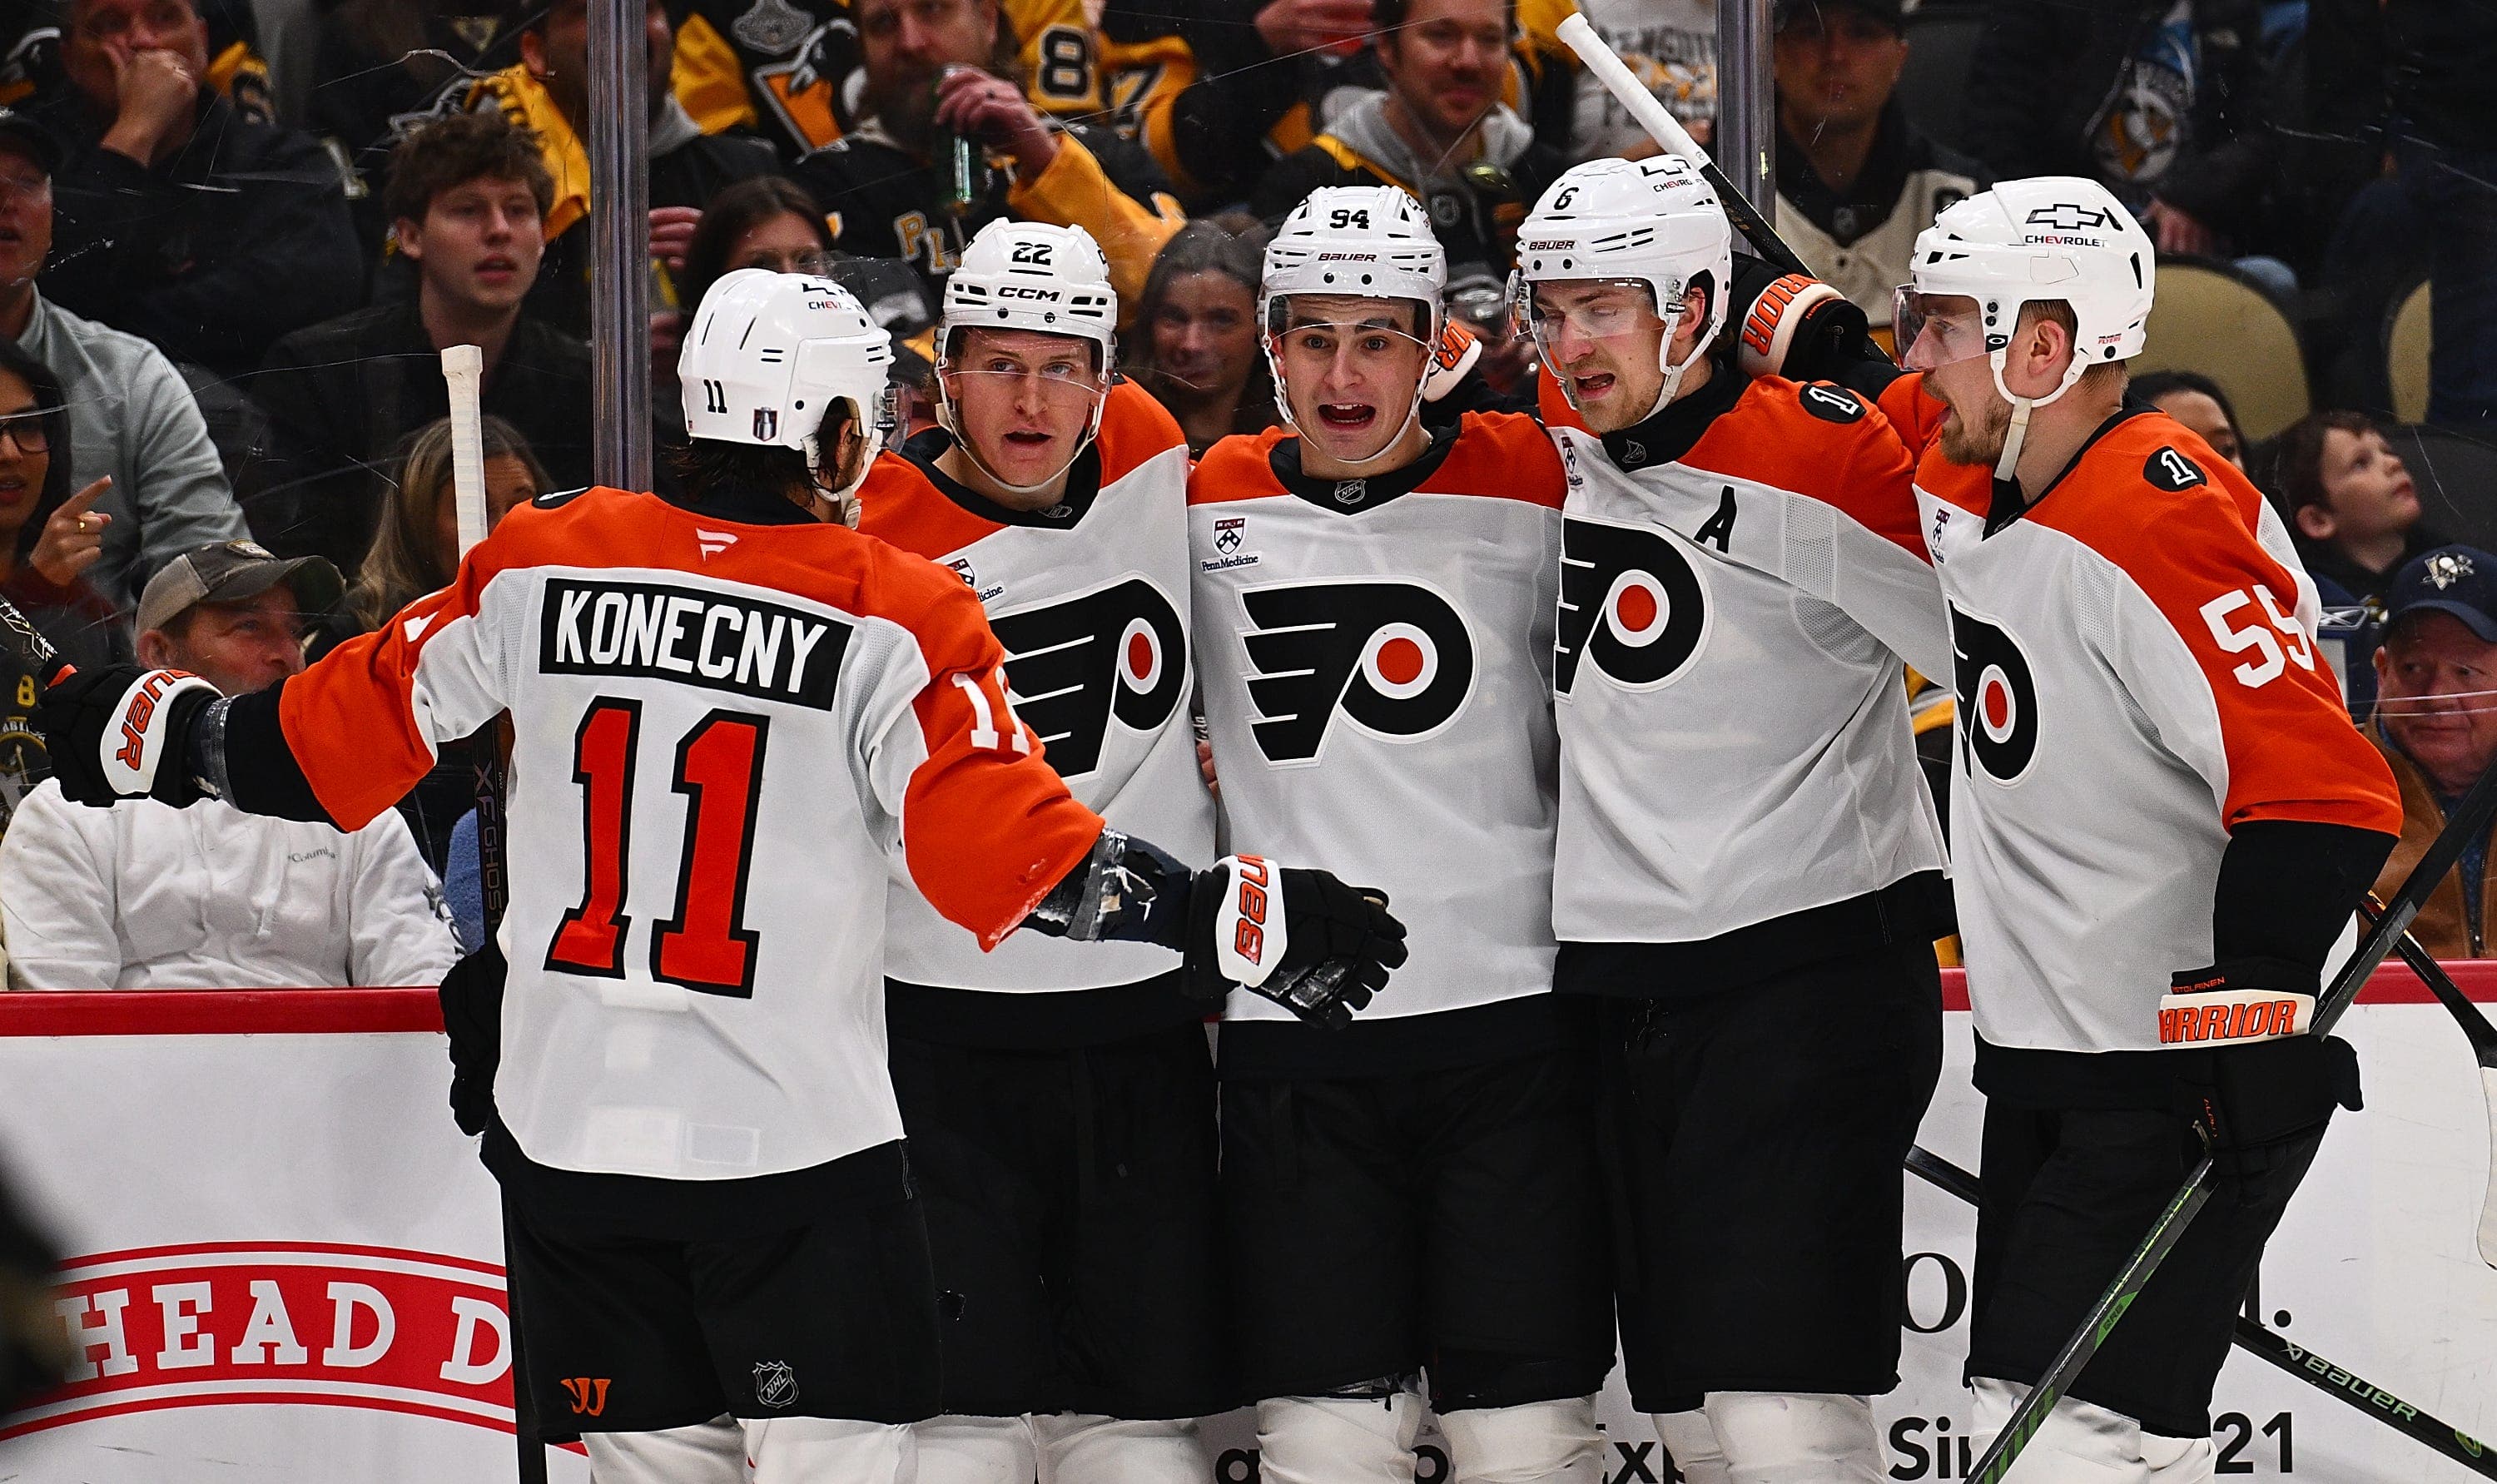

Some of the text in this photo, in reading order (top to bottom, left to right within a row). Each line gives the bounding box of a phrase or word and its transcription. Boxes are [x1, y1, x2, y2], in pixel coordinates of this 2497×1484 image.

[1553, 187, 1580, 211] 6
[1329, 209, 1370, 230] 94
[1011, 241, 1053, 266] 22
[2024, 235, 2107, 248] CHEVROLET
[997, 285, 1061, 302] CCM
[703, 379, 727, 414] 11
[2161, 449, 2198, 485] 1
[1693, 484, 1737, 554] A
[1201, 554, 1258, 572] Penn Medicine
[556, 589, 828, 693] KONECNY
[2199, 584, 2316, 689] 55
[543, 694, 771, 1000] 11
[2172, 976, 2226, 994] STOLAINEN
[2158, 1000, 2298, 1044] ARRIOR
